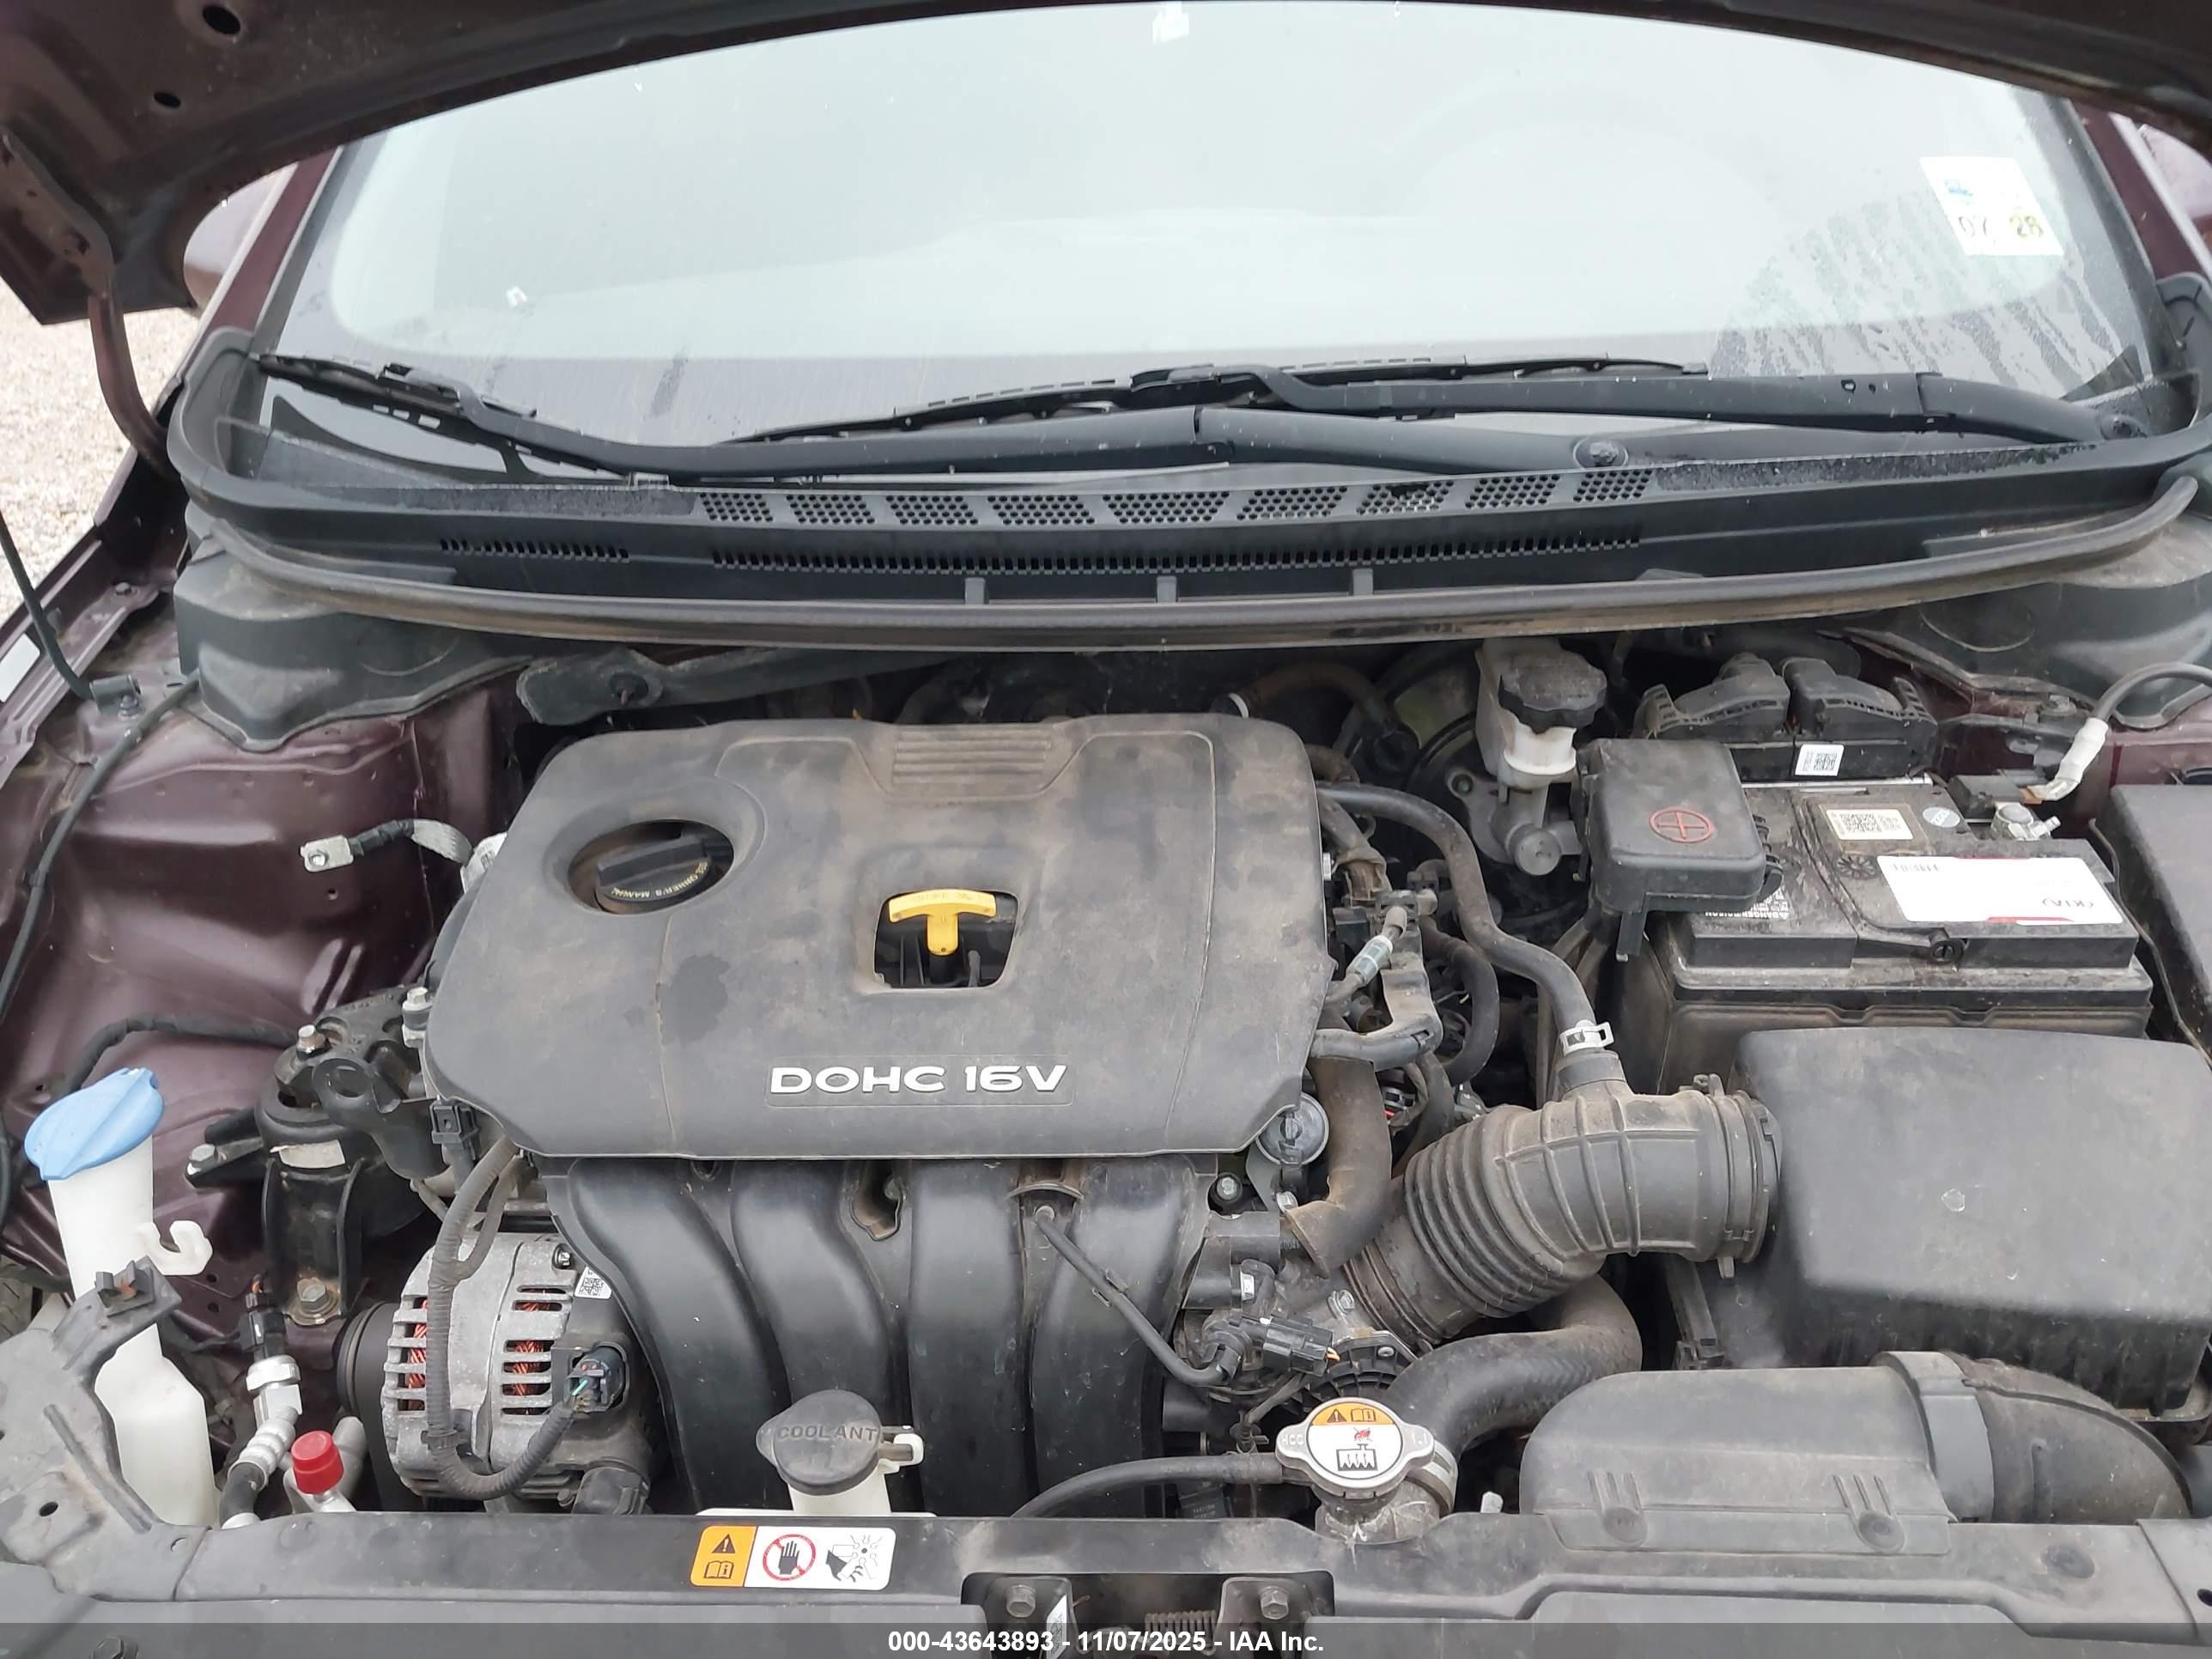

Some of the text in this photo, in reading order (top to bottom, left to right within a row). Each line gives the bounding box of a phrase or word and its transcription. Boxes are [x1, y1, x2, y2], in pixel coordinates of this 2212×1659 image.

[769, 1064, 1067, 1094] DOHC 16V
[776, 1425, 878, 1443] COOLANT
